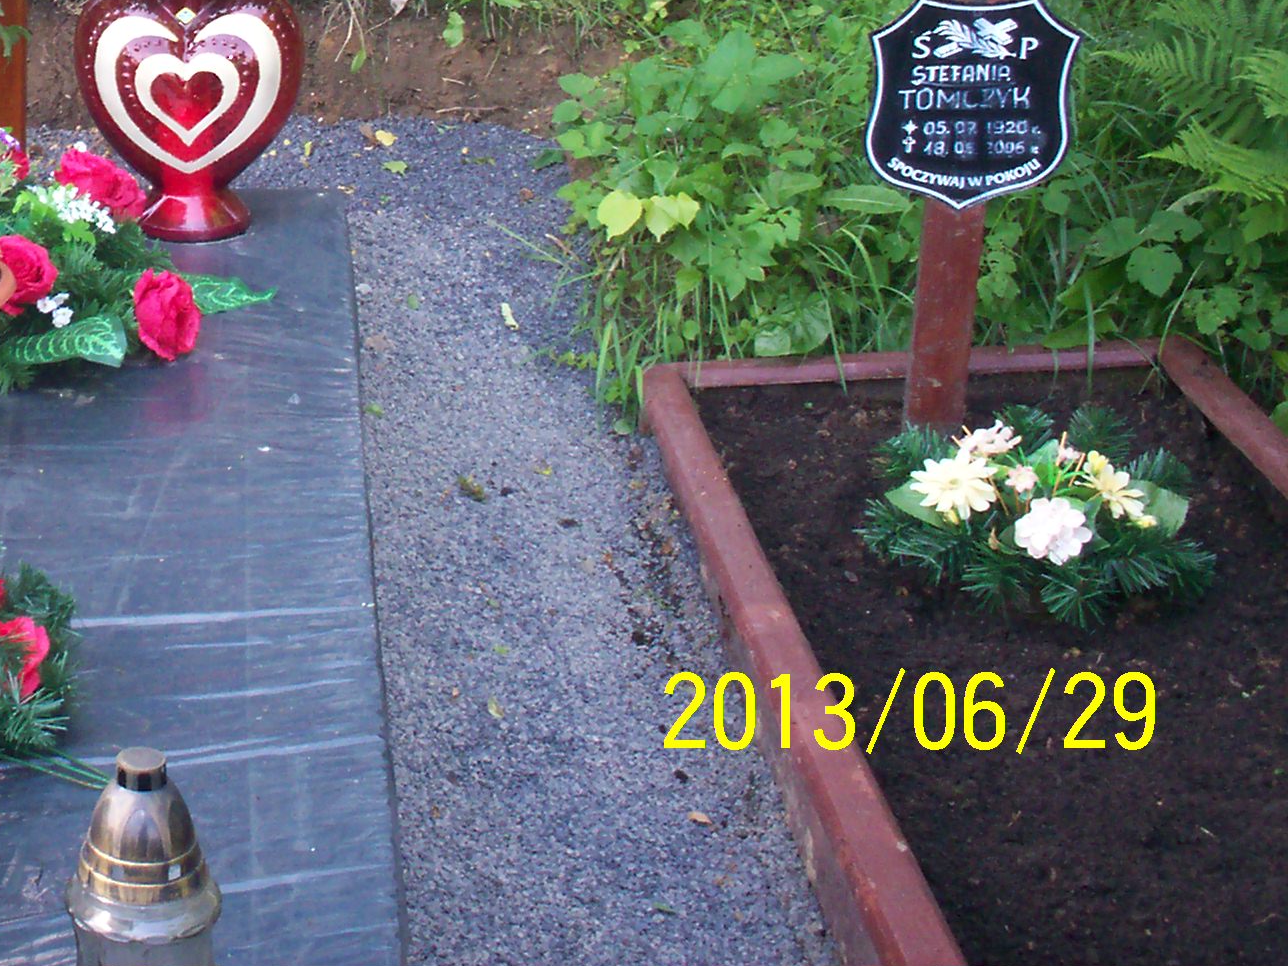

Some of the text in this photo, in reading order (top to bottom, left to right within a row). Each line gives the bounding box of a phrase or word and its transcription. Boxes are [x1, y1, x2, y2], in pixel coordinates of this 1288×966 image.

[1019, 36, 1039, 60] P
[911, 64, 1011, 85] STEFANIA
[898, 86, 1031, 111] TOMCZYK
[923, 119, 951, 135] 05.
[987, 119, 1029, 134] 1920
[887, 157, 1041, 189] SPOCZYWAJ W POKOJU
